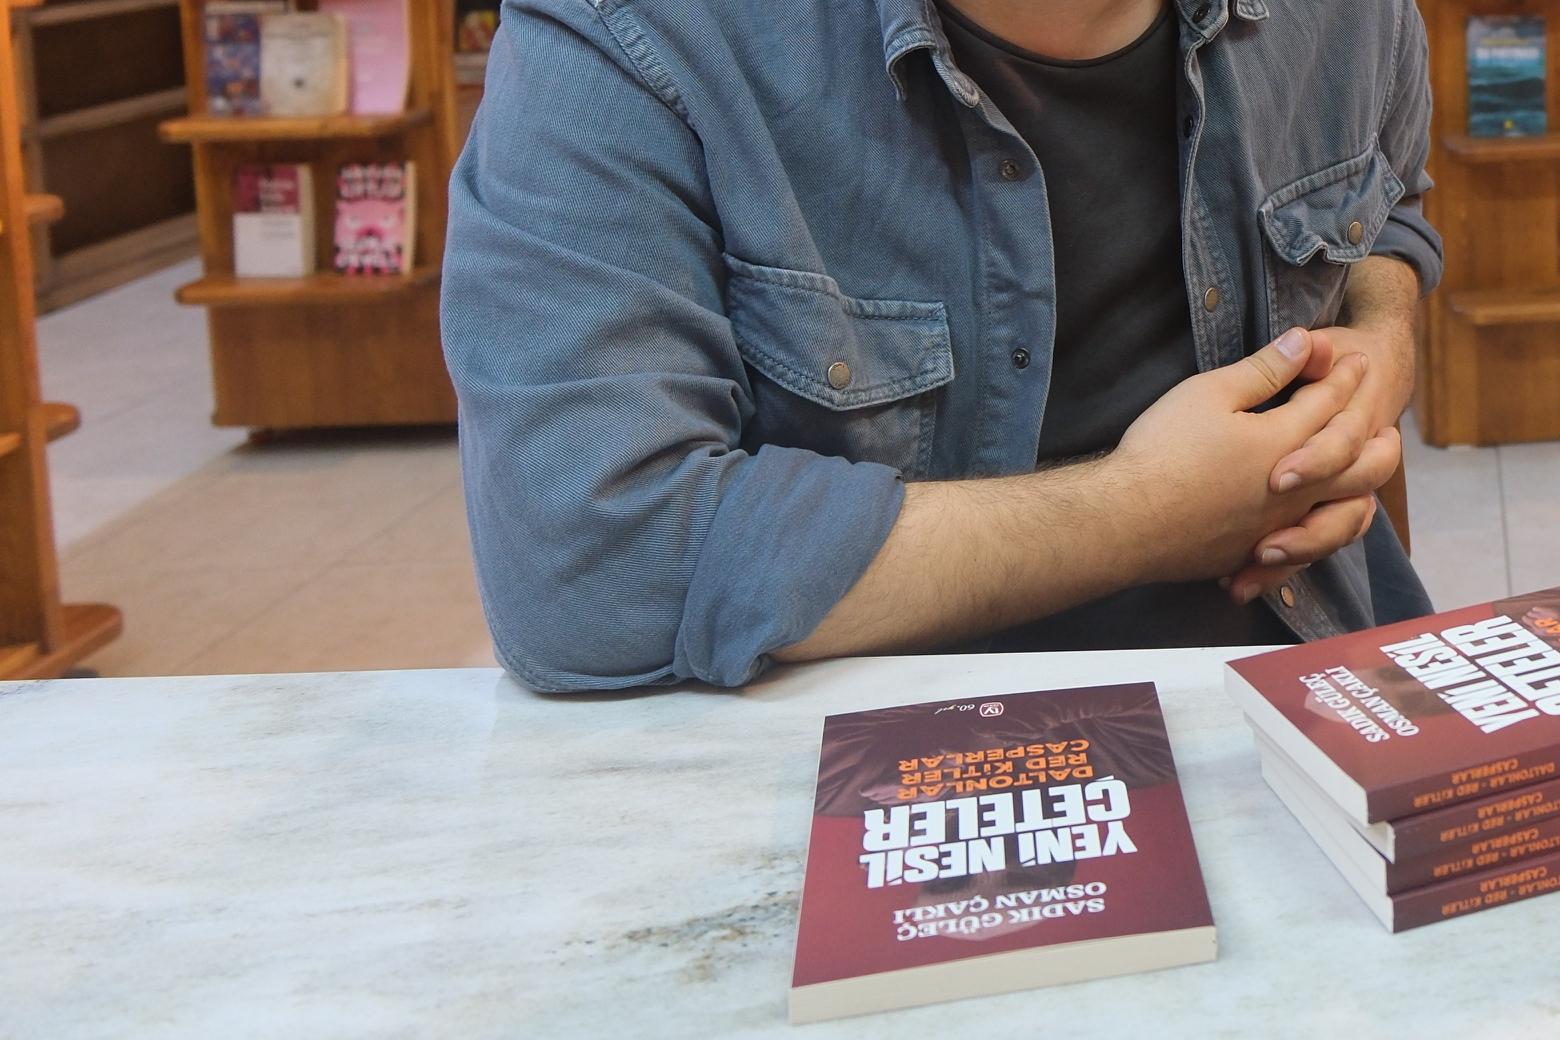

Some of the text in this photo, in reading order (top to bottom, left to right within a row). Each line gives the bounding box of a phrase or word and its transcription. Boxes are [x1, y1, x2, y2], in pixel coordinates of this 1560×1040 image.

[1378, 632, 1540, 734] YENİ NESİL
[1298, 672, 1391, 743] SADIK GÜLEÇ
[1324, 665, 1420, 737] OSMAN ÇAKLI
[898, 739, 1090, 771] CASPERLAR
[901, 751, 1088, 785] RED KİTLER
[896, 765, 1094, 800] DALTONLAR
[1452, 759, 1518, 784] CASPERLAR
[1490, 762, 1555, 788] DALTONLAR
[1413, 786, 1454, 808] KİTLER
[1456, 780, 1479, 796] RED
[862, 775, 1131, 852] ÇETELER
[1478, 792, 1543, 818] CASPERLAR
[1440, 821, 1480, 843] KİTLER
[1483, 814, 1504, 830] RED
[859, 820, 1138, 888] YENİ NESİL
[1472, 828, 1539, 854] CASPERLAR
[1433, 856, 1473, 877] KİTLER
[1476, 849, 1499, 864] RED
[1479, 866, 1547, 893] CASPERLAR
[893, 881, 1108, 922] OSMAN ÇAKLI
[1441, 893, 1481, 915] KİTLER
[1484, 888, 1507, 903] RED
[896, 897, 1106, 941] SADIK GÜLEÇ
